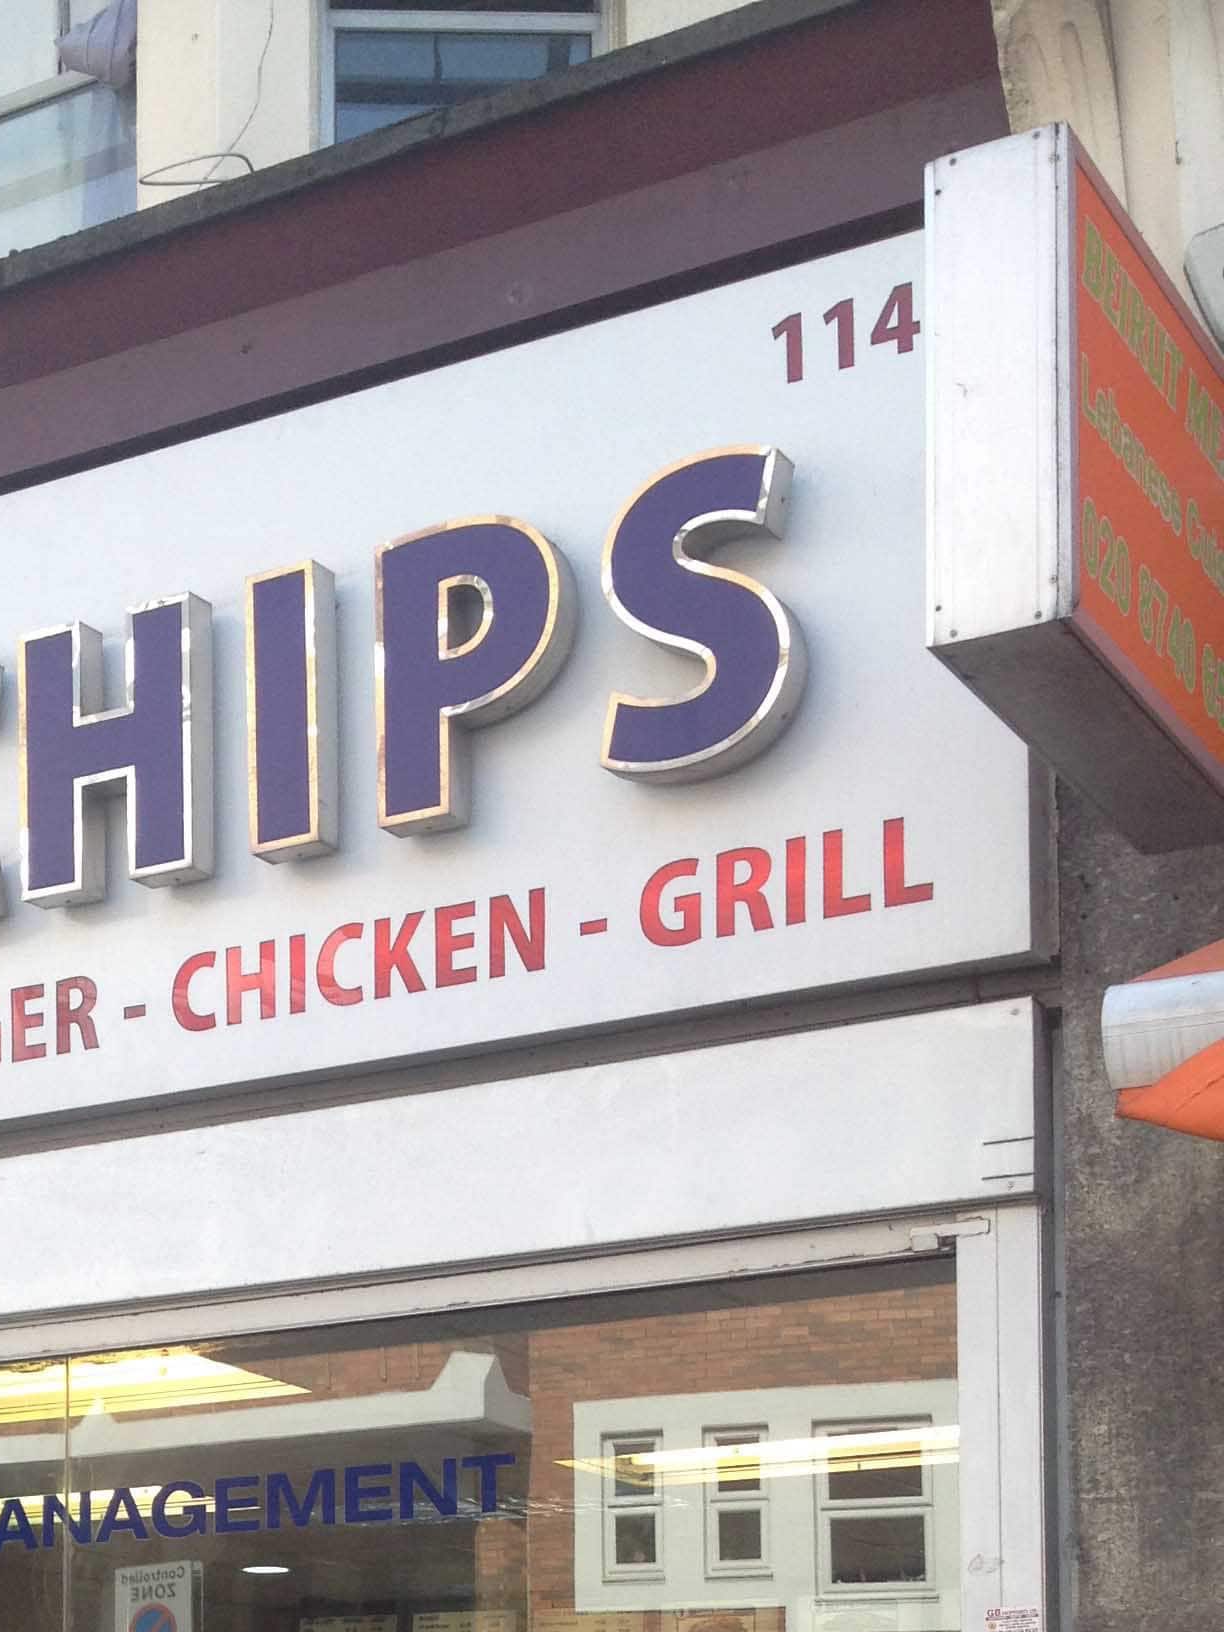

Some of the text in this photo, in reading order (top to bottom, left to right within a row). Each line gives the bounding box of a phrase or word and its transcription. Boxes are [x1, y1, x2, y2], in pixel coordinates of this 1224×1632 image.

[771, 282, 920, 384] 114
[1082, 215, 1184, 414] BEIRUT
[1082, 352, 1182, 536] Lebanese
[1082, 496, 1132, 616] 020
[1138, 564, 1196, 693] 8740
[171, 887, 546, 1032] CHICKEN
[639, 817, 934, 947] GRILL
